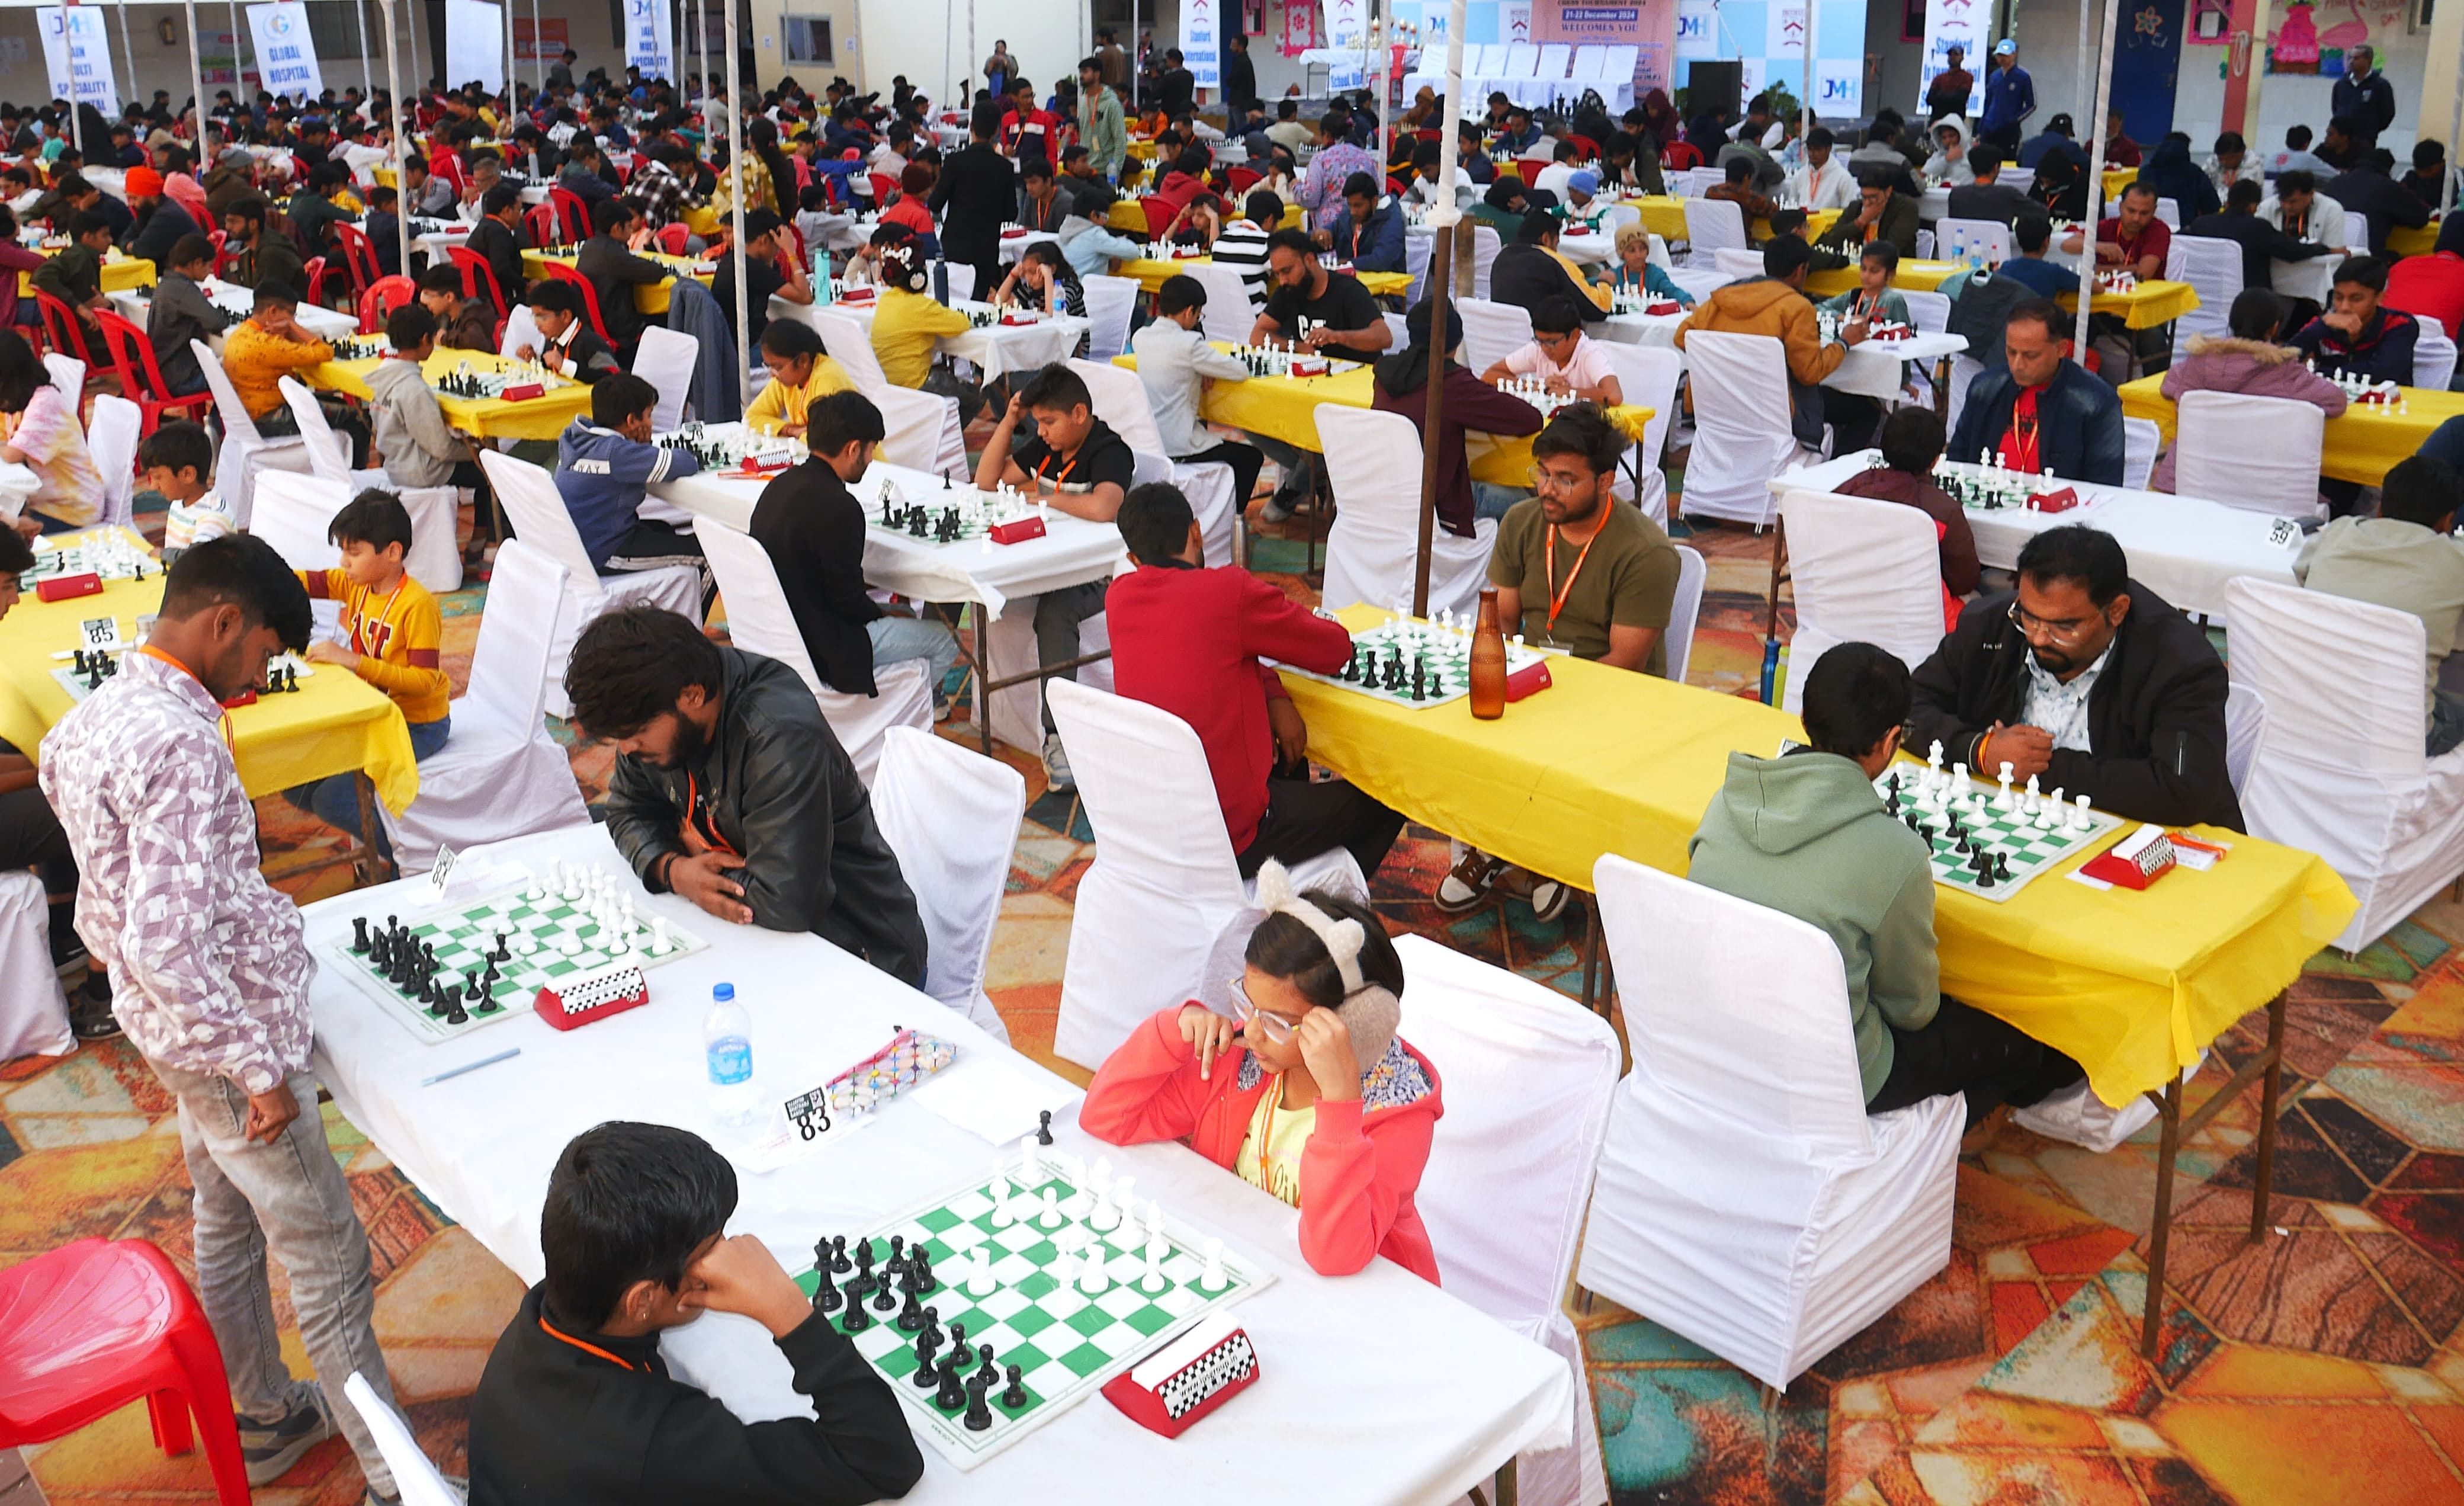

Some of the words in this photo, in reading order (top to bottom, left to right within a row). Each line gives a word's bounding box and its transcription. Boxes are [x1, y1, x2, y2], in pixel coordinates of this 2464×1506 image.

[1584, 9, 1617, 20] December
[1561, 23, 1614, 32] WELCOMES
[1618, 23, 1638, 31] YOU
[269, 45, 301, 62] GLOBAL
[269, 66, 310, 84] HOSPITAL
[1823, 79, 1856, 98] JMH
[89, 626, 114, 644] 85
[432, 861, 448, 890] 84
[797, 1106, 831, 1141] 83
